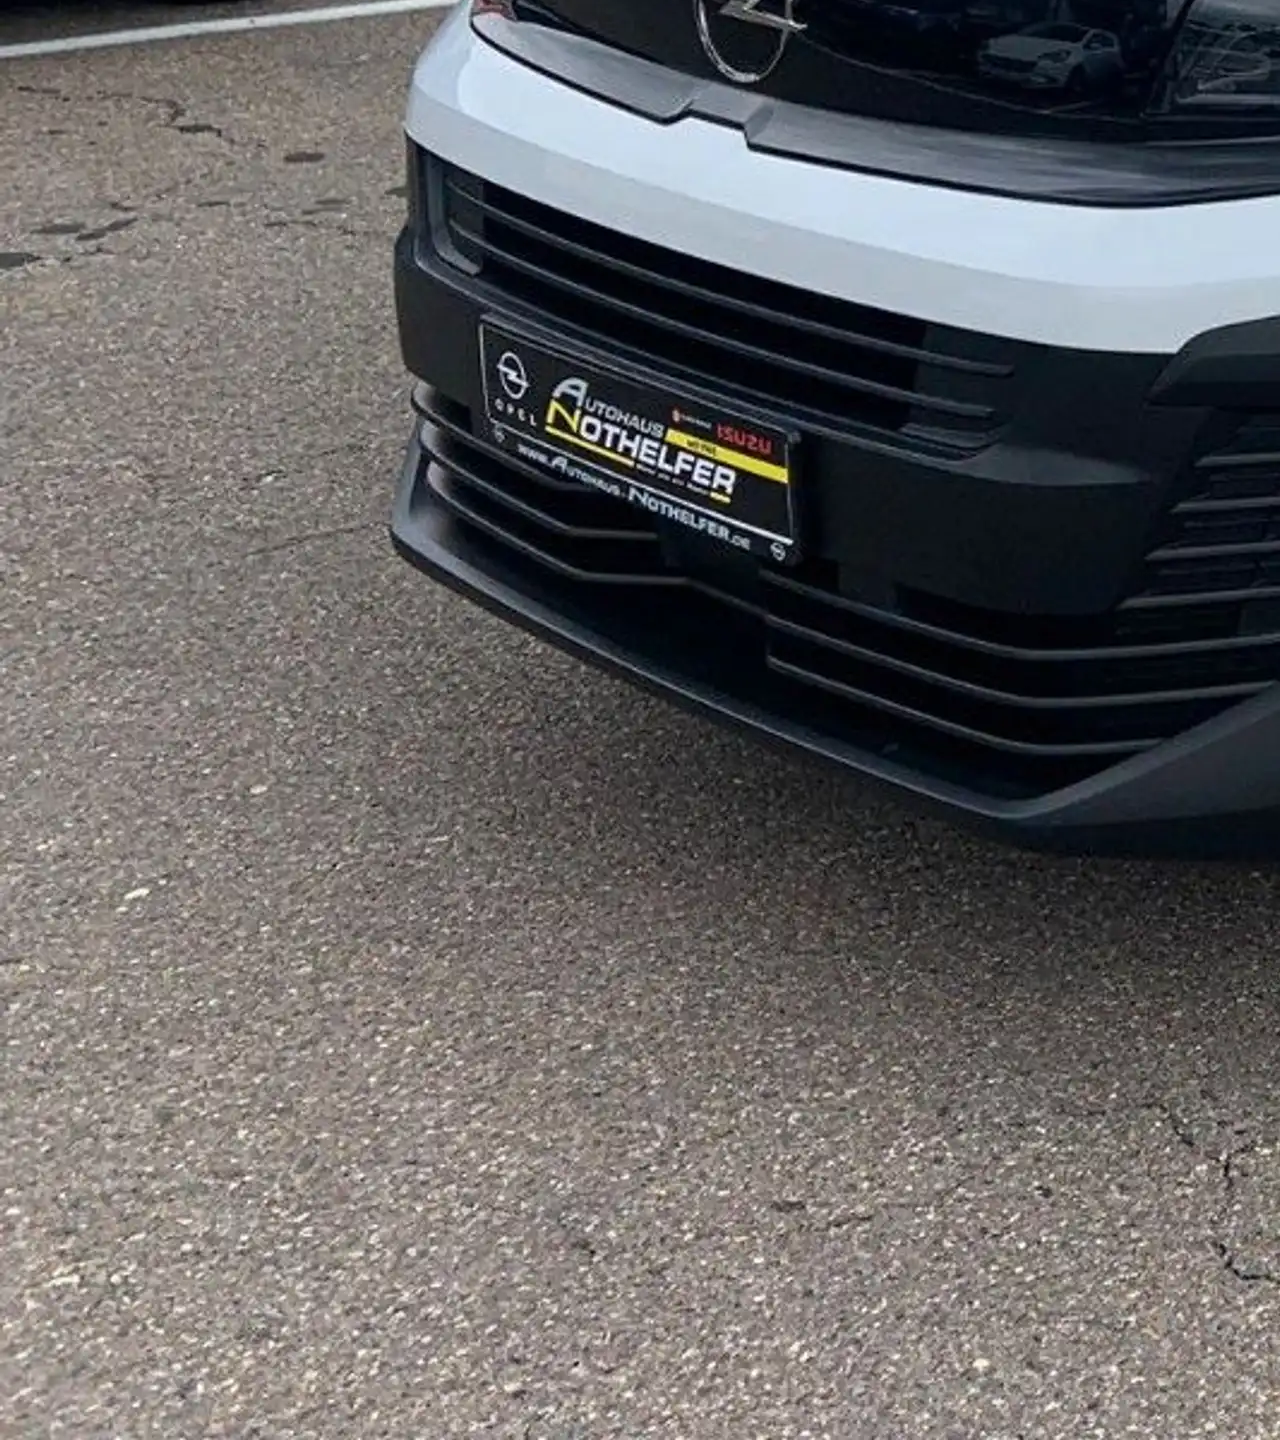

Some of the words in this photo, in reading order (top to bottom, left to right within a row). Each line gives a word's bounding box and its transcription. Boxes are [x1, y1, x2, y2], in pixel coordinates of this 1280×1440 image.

[552, 377, 665, 439] AUTOHAUS
[546, 398, 737, 495] NOTHELFER
[716, 424, 773, 455] ISUZU
